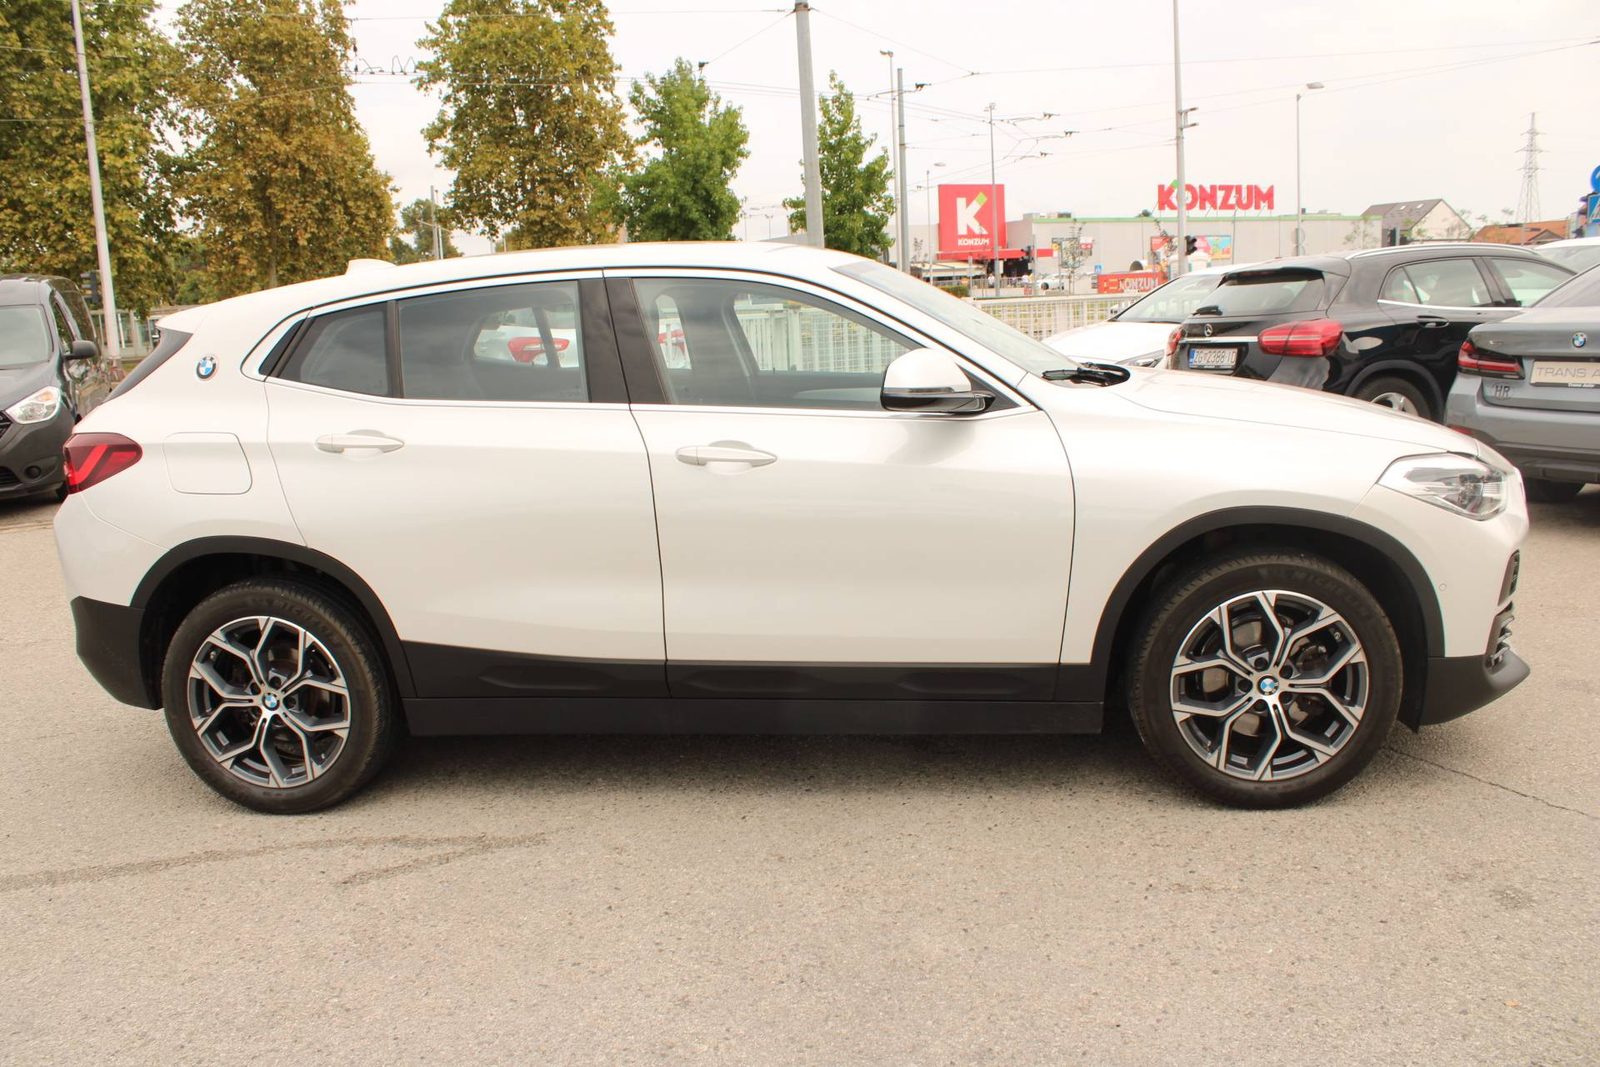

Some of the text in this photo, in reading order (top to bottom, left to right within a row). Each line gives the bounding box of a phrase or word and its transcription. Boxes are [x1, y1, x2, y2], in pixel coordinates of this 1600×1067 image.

[1157, 180, 1274, 211] KONZUM
[958, 238, 989, 246] KONZUM
[1536, 367, 1586, 377] TRANS
